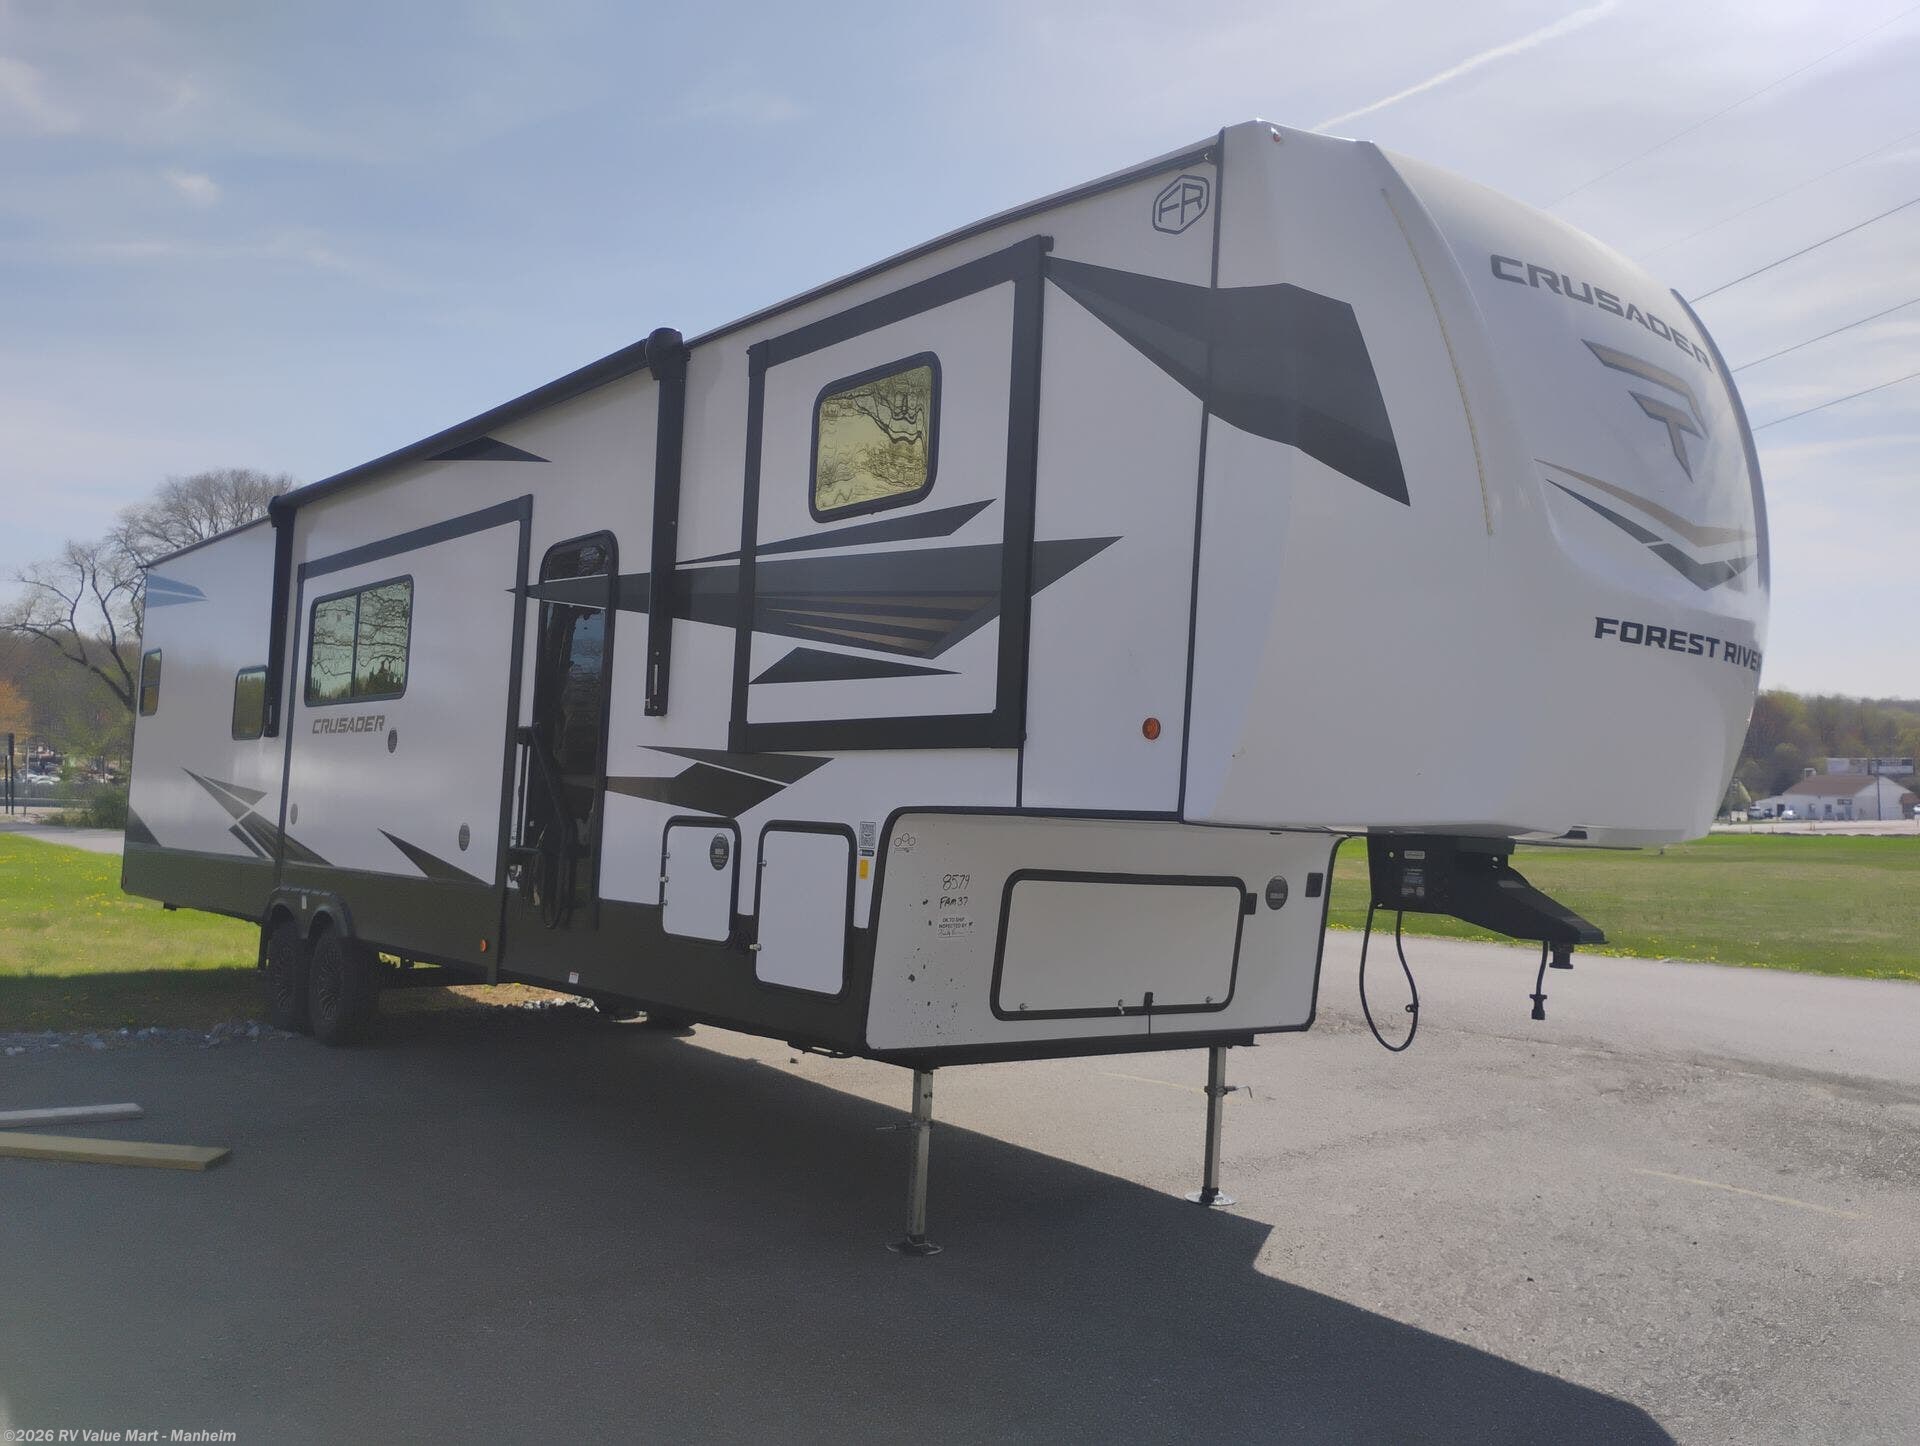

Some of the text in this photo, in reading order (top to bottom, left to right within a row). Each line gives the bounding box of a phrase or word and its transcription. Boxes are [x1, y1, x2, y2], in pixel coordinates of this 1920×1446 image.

[1489, 253, 1713, 373] CRUSADER
[1594, 616, 1720, 658] FOREST
[312, 715, 386, 734] CRUSADER
